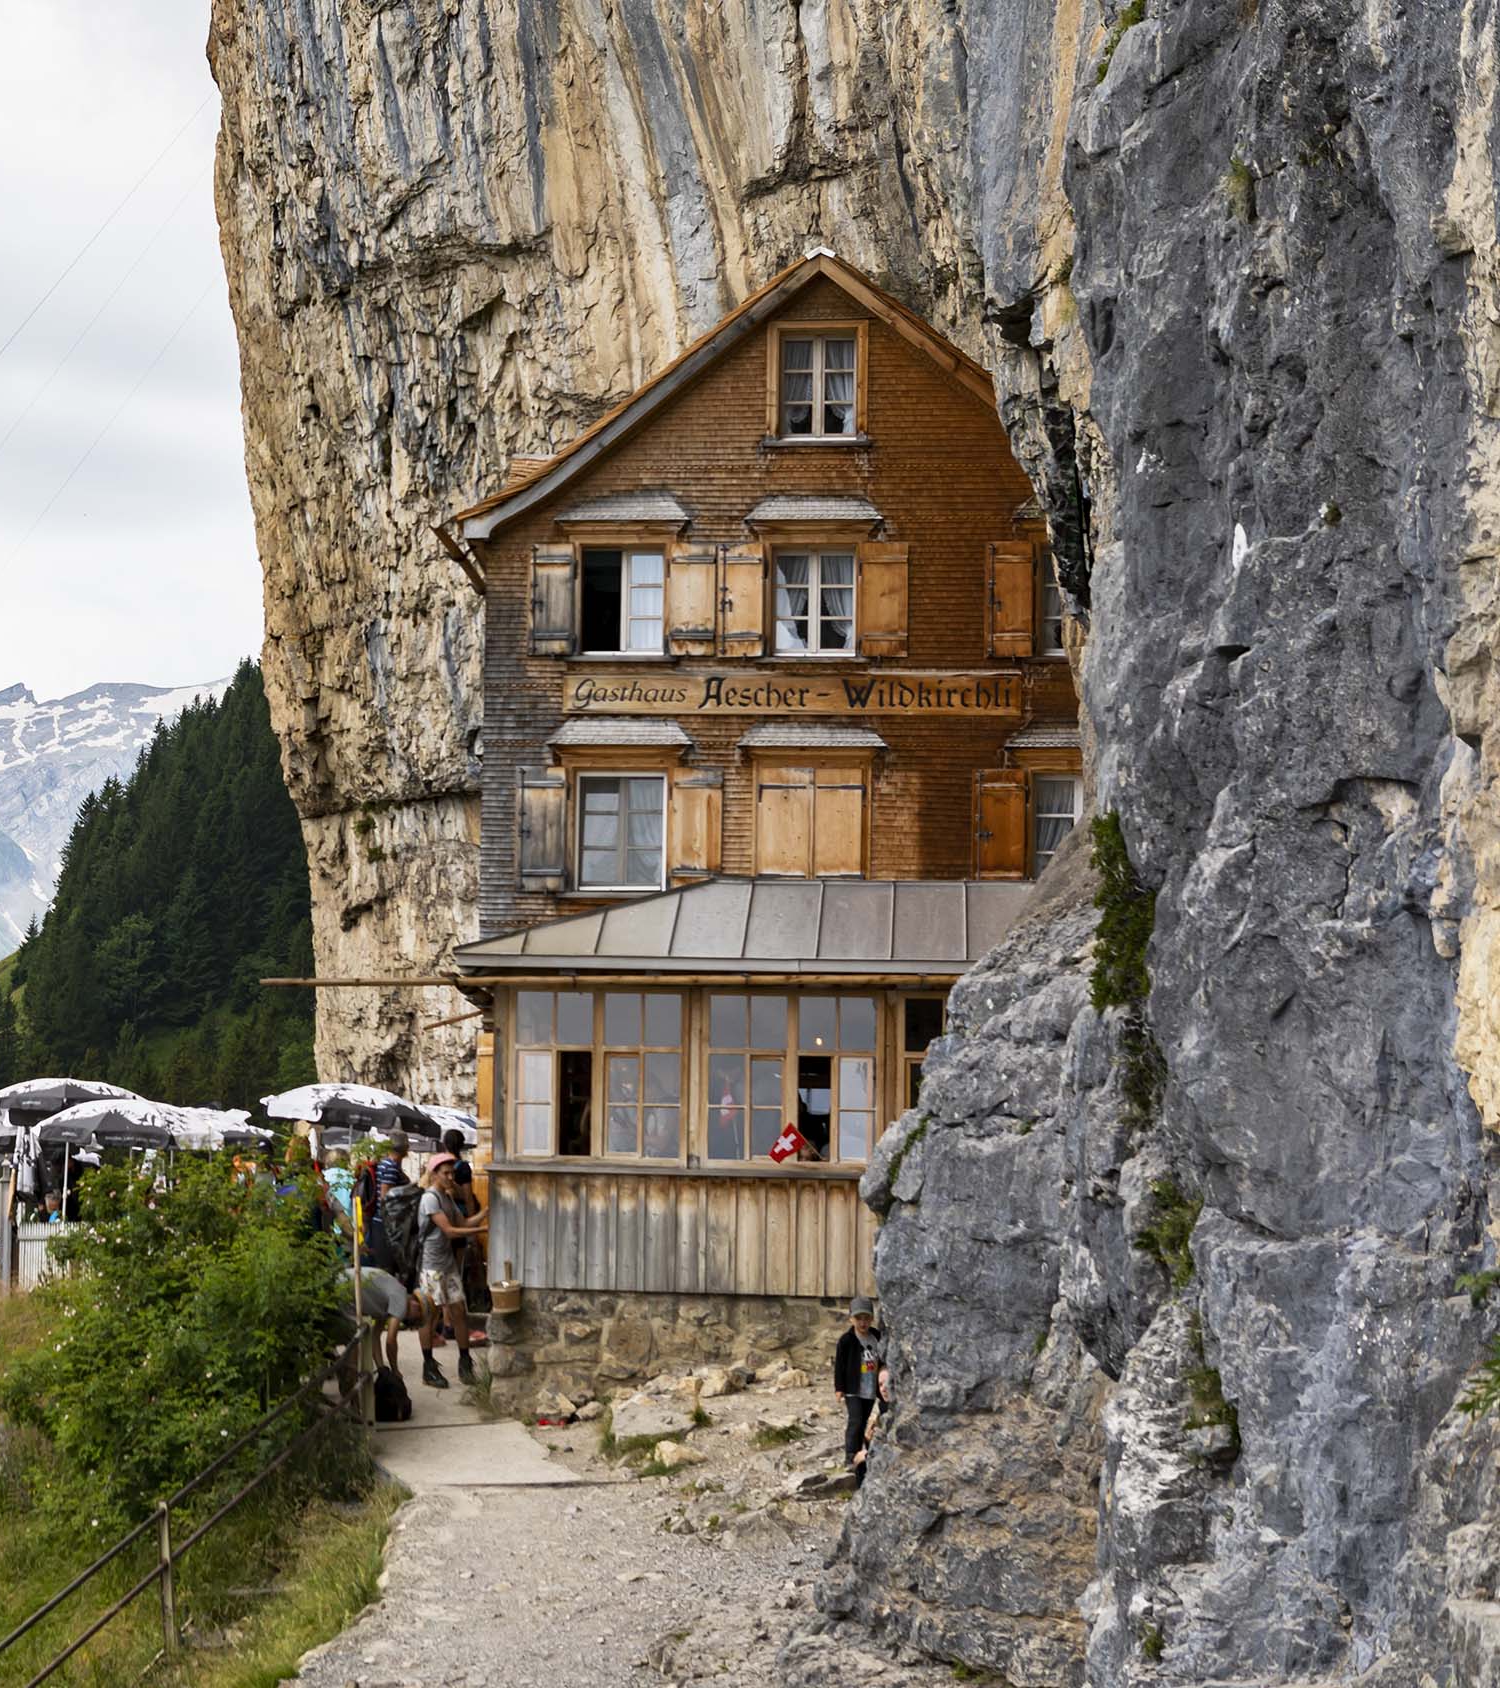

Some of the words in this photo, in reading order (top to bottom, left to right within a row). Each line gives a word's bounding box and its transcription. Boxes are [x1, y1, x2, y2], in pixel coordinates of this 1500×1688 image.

[573, 678, 687, 709] Gasthaus
[698, 677, 809, 708] Aescher
[842, 678, 1012, 709] Wildkirchli
